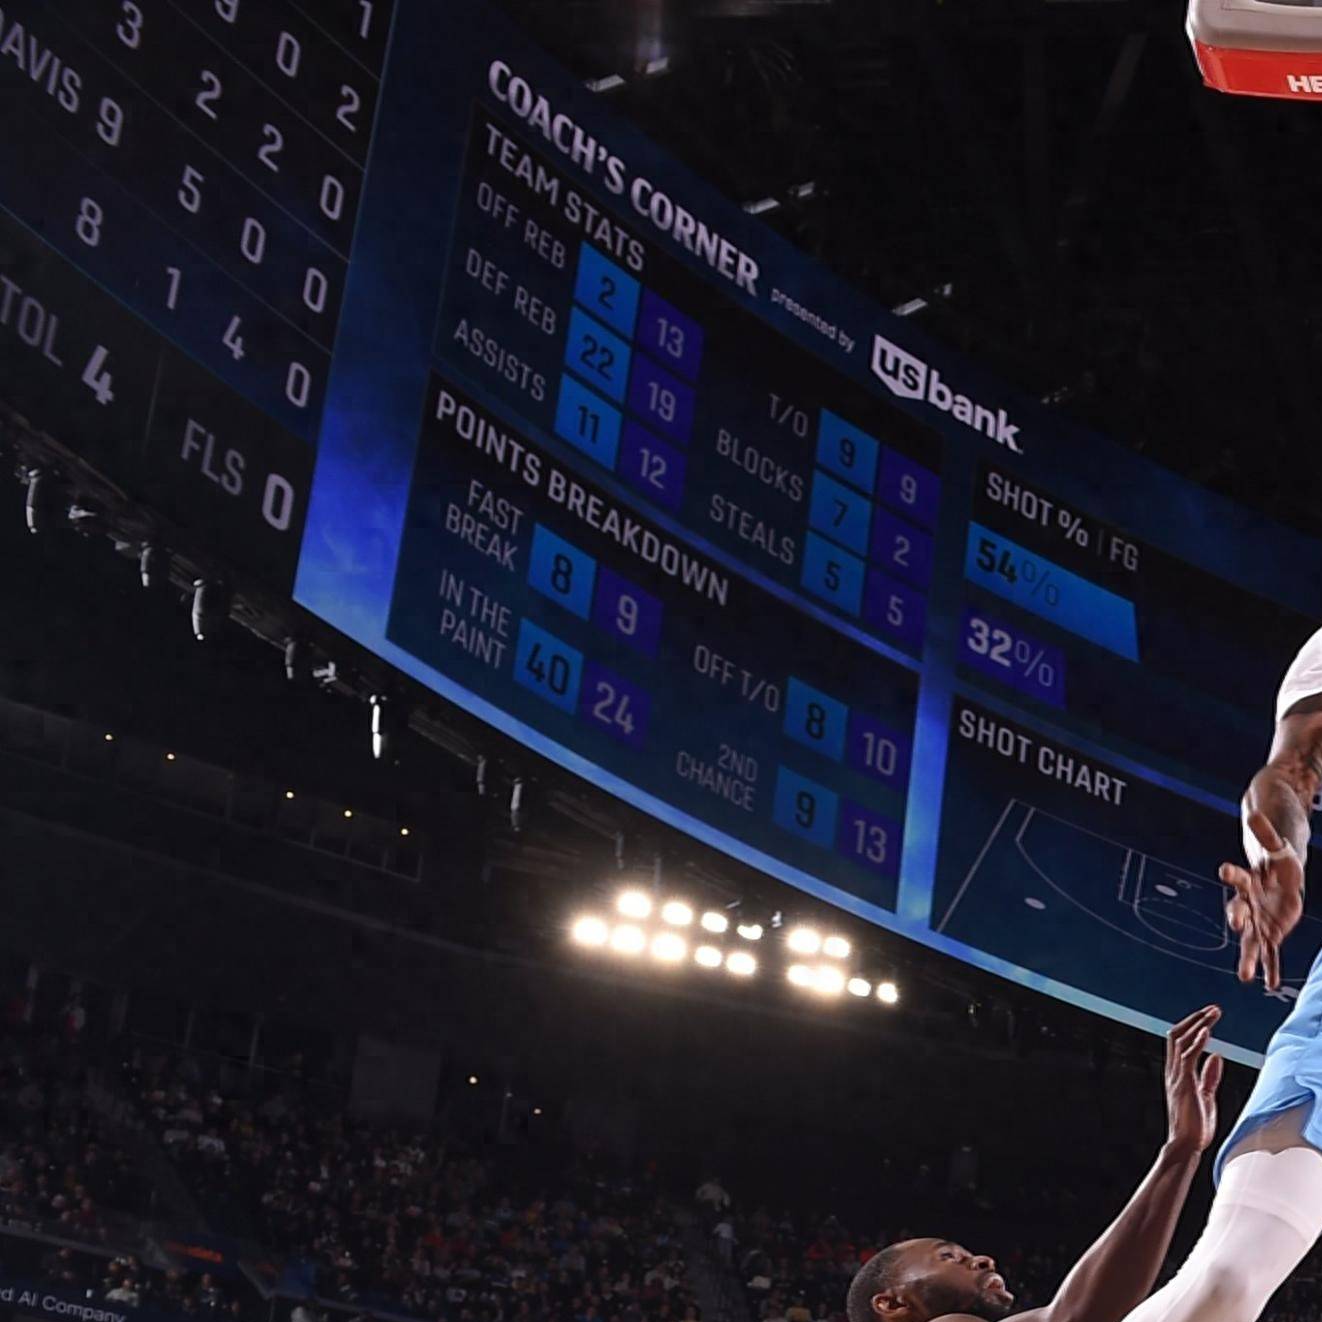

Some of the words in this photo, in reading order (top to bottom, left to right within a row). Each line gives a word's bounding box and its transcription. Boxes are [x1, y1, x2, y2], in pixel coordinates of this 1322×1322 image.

[0, 20, 82, 114] AVIS
[96, 97, 123, 146] 9
[178, 165, 204, 213] 5
[196, 70, 222, 118] 2
[259, 123, 283, 172] 2
[336, 85, 360, 131] 2
[485, 123, 560, 206] TEAM
[564, 191, 645, 271] STATS
[488, 60, 625, 194] COACH'S
[630, 177, 760, 296] CORNER
[771, 286, 836, 340] presented
[838, 327, 855, 352] by
[76, 197, 101, 247] 8
[167, 267, 181, 309] 1
[222, 316, 245, 360] 4
[466, 248, 509, 296] DEF
[514, 286, 557, 336] REB
[580, 335, 614, 381] 22
[649, 382, 677, 423] 19
[477, 183, 519, 230] OFF
[524, 219, 566, 269] REB
[600, 277, 616, 310] 2
[657, 317, 685, 359] 13
[0, 274, 62, 367] TOL
[82, 345, 114, 404] 4
[453, 318, 547, 401] ASSISTS
[577, 404, 600, 444] 11
[640, 449, 667, 489] 12
[182, 419, 245, 496] FLS
[262, 472, 295, 531] 0
[436, 390, 541, 487] POINTS
[548, 470, 728, 606] BREAKDOWN
[468, 479, 525, 535] FAST
[716, 428, 804, 502] BLOCKS
[894, 536, 909, 567] 2
[986, 472, 1053, 526] SHOT
[1110, 537, 1139, 572] FG
[439, 570, 464, 607] IN
[470, 587, 512, 638] THE
[445, 504, 519, 573] BREAK
[551, 554, 573, 595] 8
[616, 595, 638, 636] 9
[710, 494, 795, 565] STEALS
[888, 595, 903, 626] 5
[440, 609, 507, 670] PAINT
[526, 643, 570, 697] 40
[593, 682, 635, 735] 24
[694, 645, 736, 685] OFF
[806, 703, 826, 740] 8
[863, 732, 896, 776] 10
[676, 752, 756, 811] CHANCE
[795, 792, 816, 829] 9
[854, 820, 888, 863] 13
[718, 745, 758, 783] 2ND
[958, 709, 1031, 764] SHOT
[1039, 746, 1128, 807] CHART
[18, 1291, 37, 1308] AI
